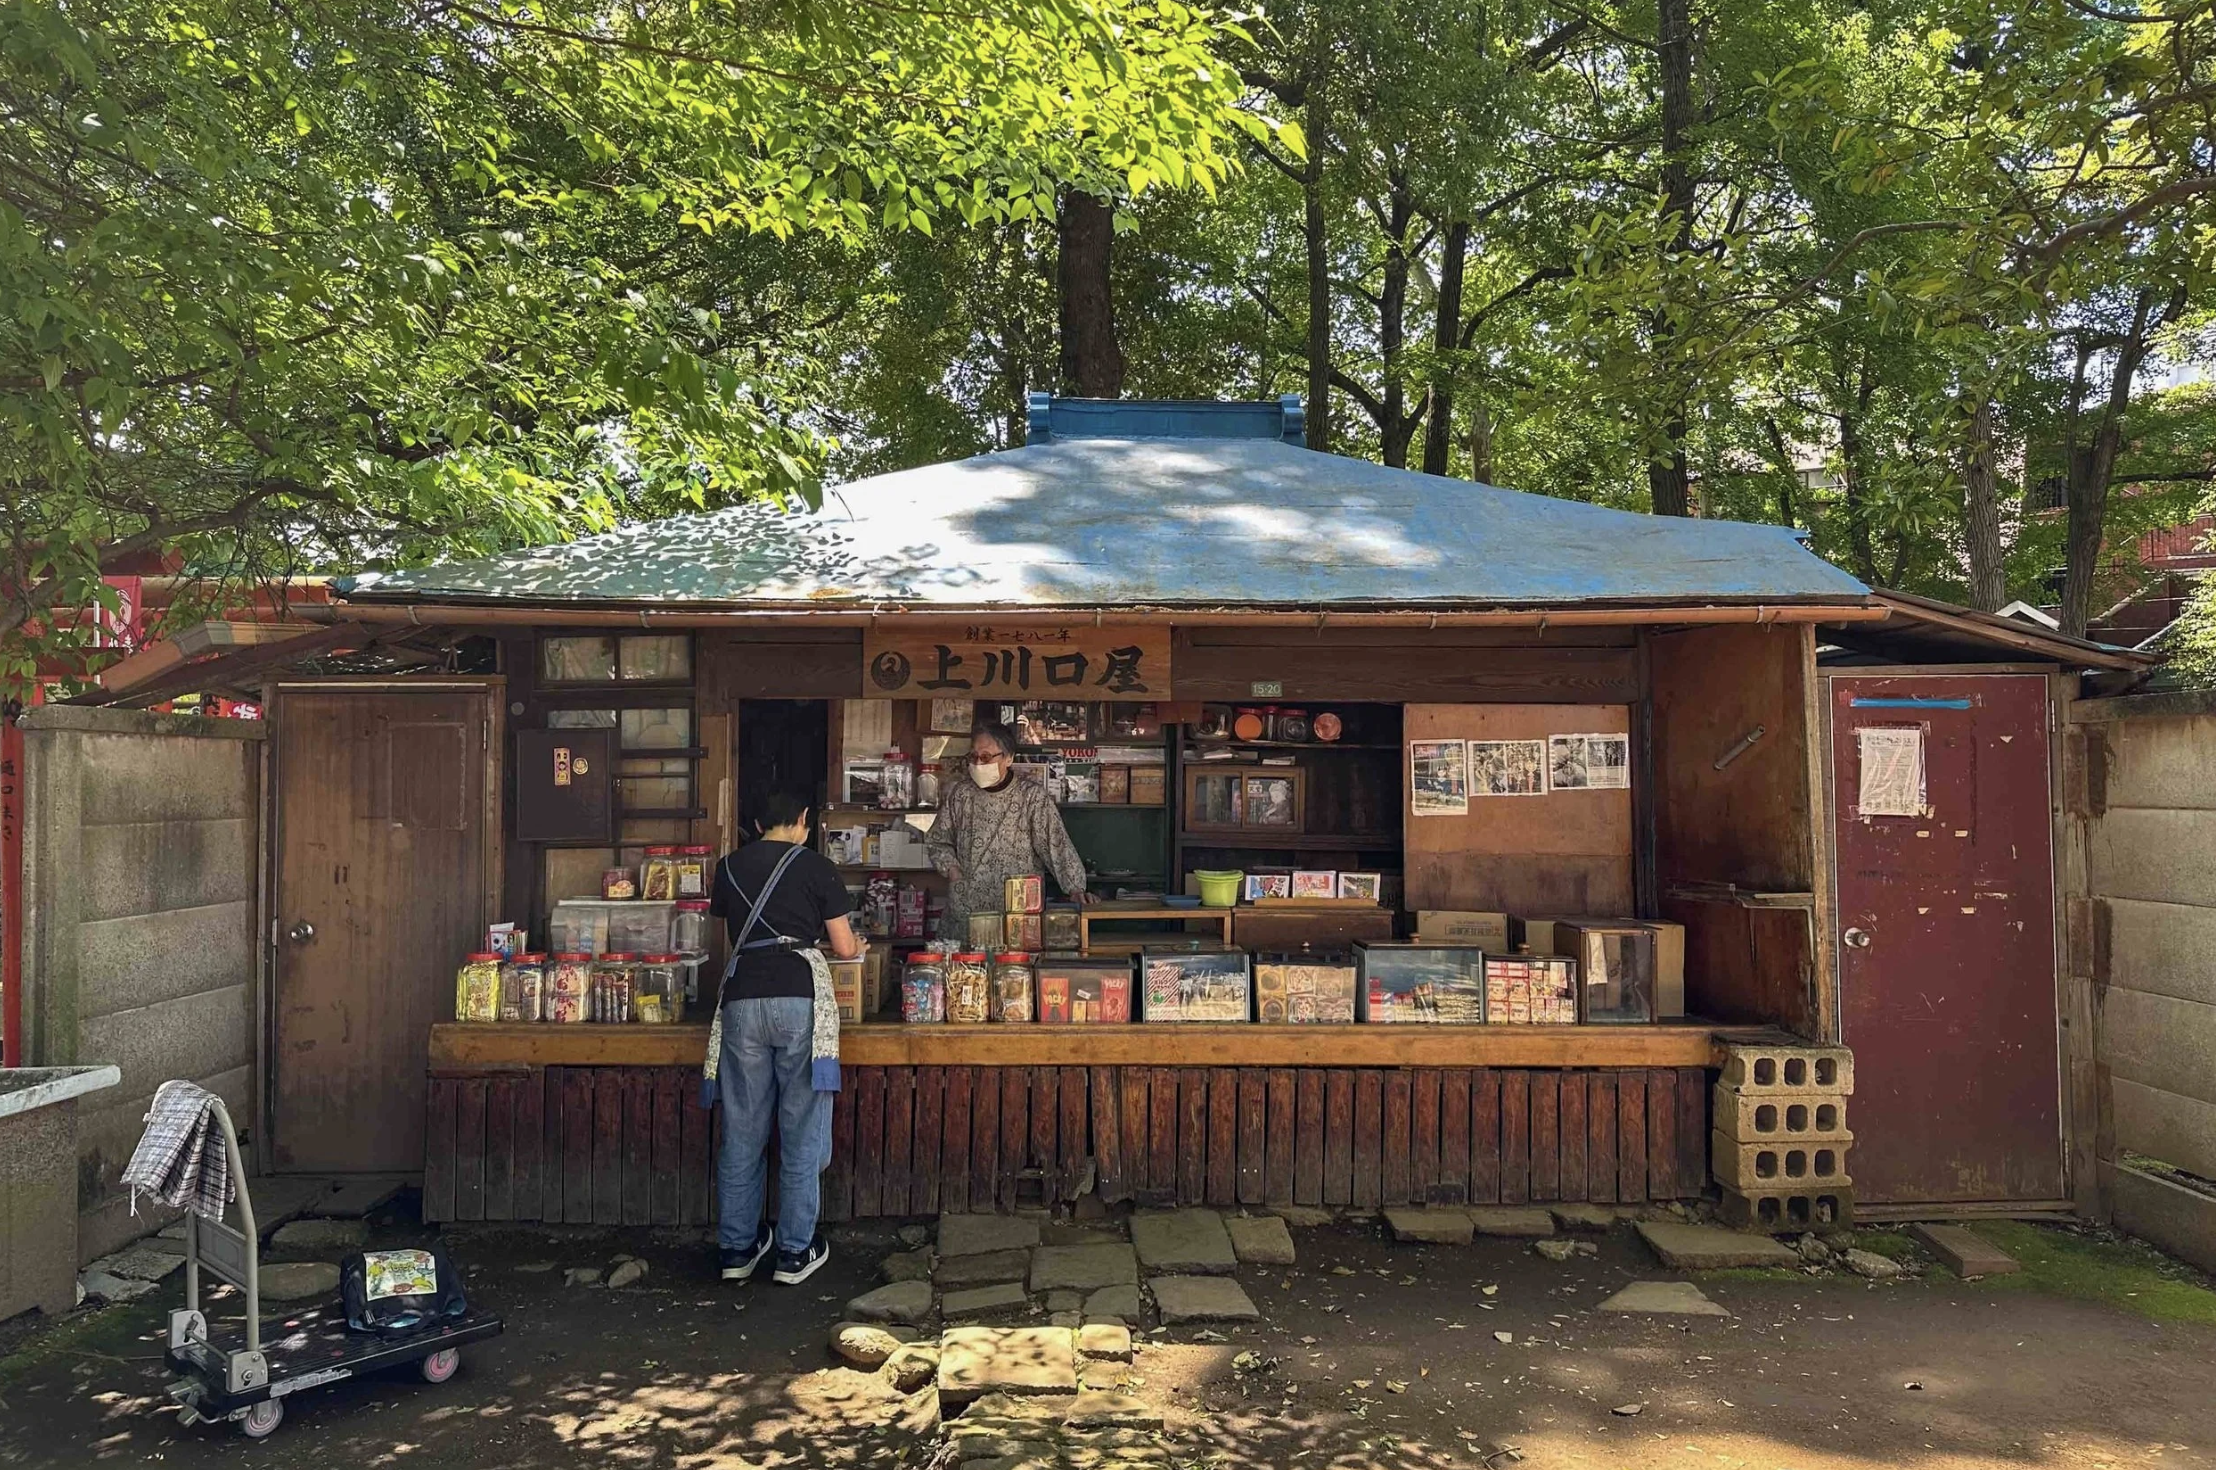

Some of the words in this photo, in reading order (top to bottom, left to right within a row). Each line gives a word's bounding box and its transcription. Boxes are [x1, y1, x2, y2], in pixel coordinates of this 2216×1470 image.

[965, 626, 1071, 643] 創業一七八一年
[917, 644, 1149, 694] 上川口屋
